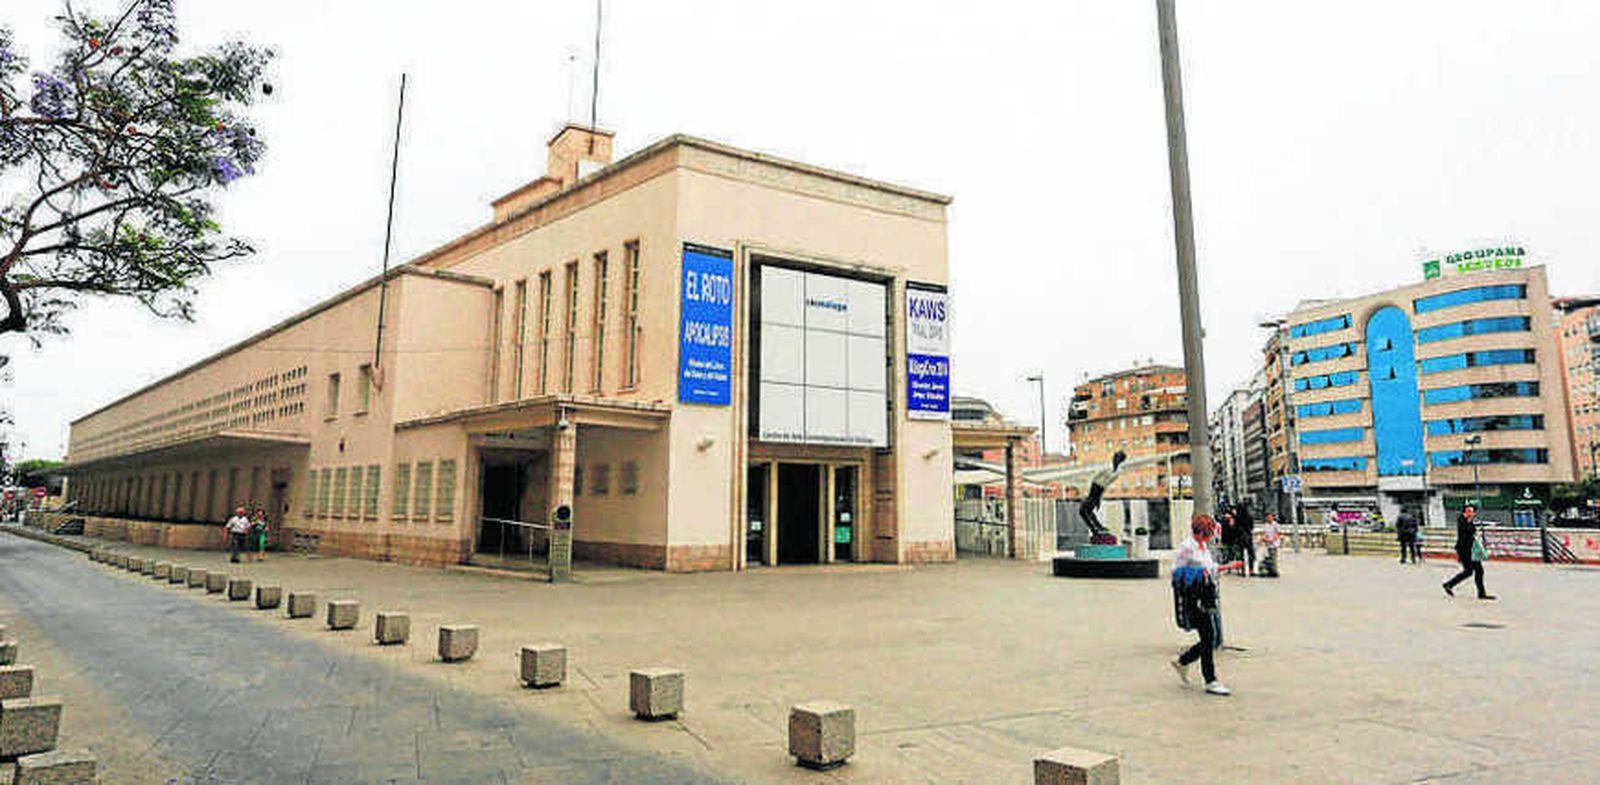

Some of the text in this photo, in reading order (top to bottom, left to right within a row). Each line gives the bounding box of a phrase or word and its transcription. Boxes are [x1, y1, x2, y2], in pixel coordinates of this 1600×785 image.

[686, 270, 731, 305] EL ROTO
[909, 296, 946, 322] KAWS
[684, 320, 730, 348] APOCALIPSIS
